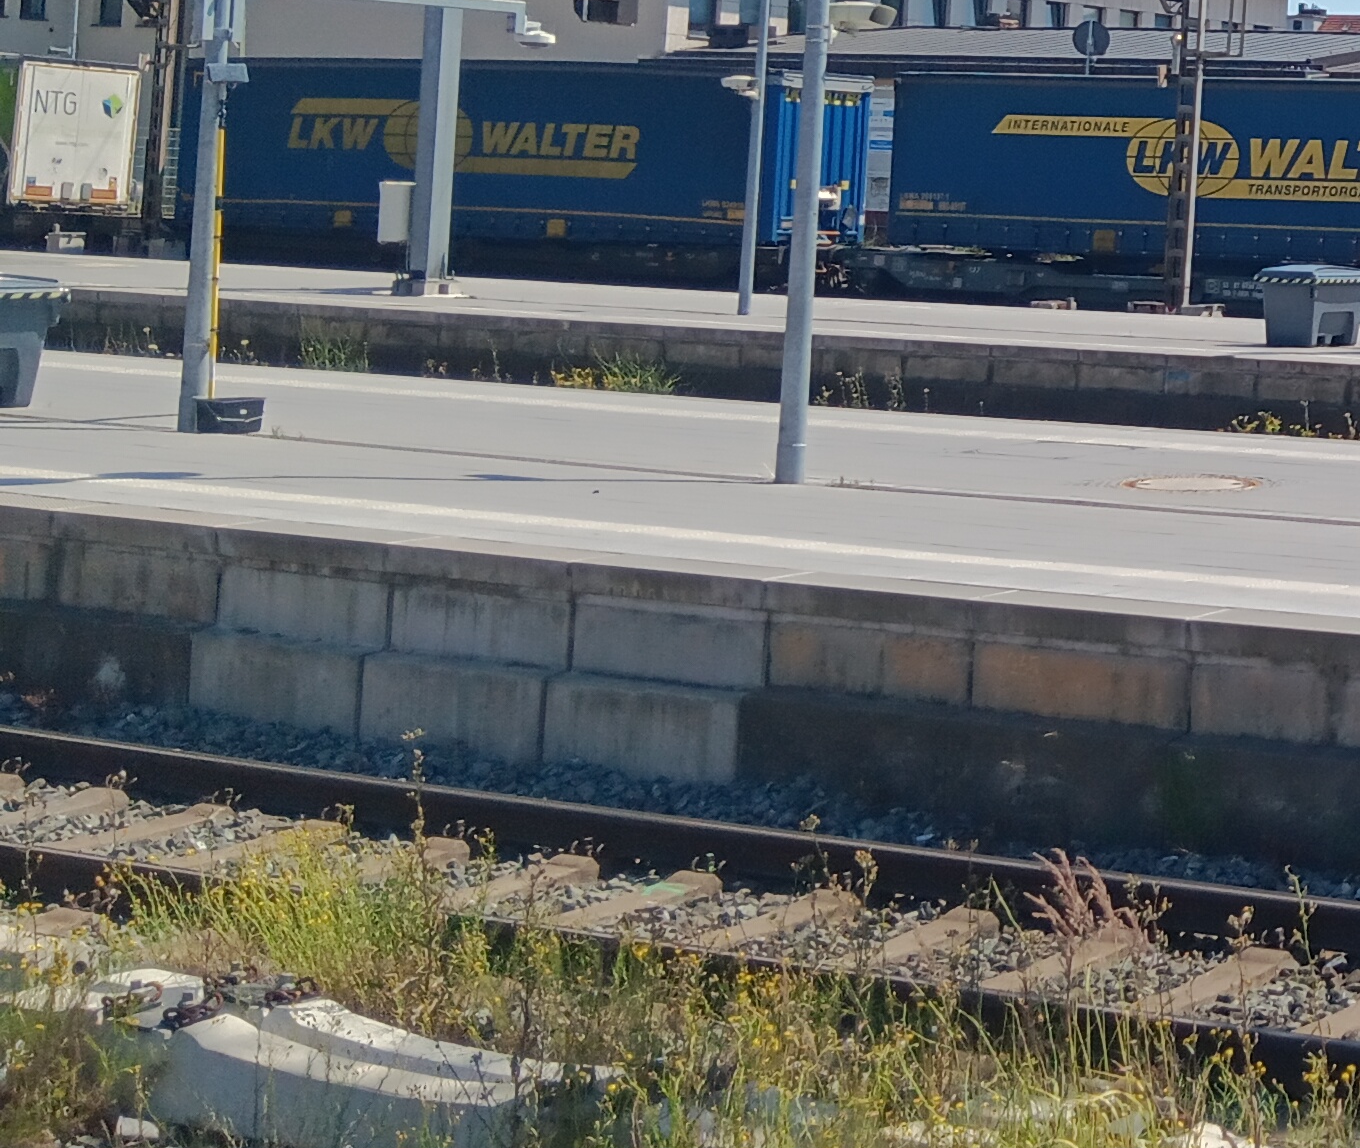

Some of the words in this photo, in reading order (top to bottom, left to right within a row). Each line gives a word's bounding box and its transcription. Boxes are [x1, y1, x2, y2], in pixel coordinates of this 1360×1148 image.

[34, 89, 77, 115] NTG
[288, 113, 379, 151] LKW
[481, 121, 639, 160] WALTER
[1007, 117, 1130, 135] INTERNATIONALE
